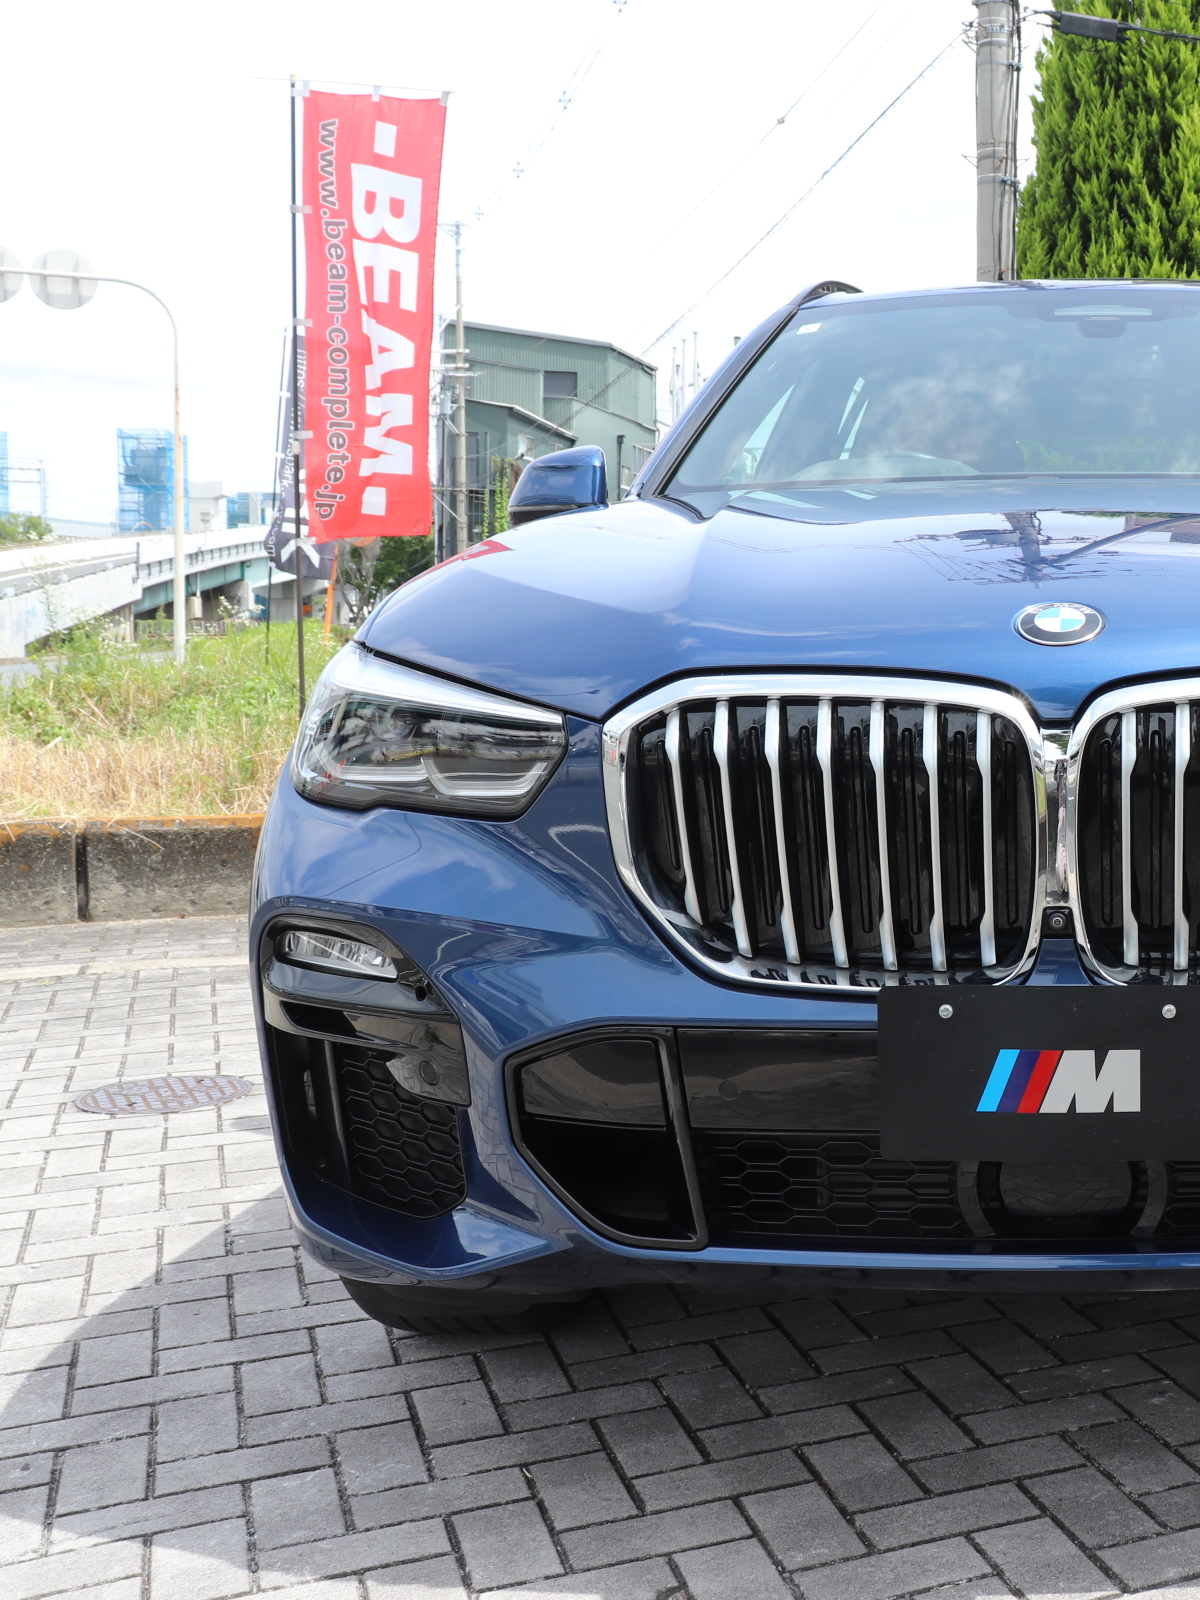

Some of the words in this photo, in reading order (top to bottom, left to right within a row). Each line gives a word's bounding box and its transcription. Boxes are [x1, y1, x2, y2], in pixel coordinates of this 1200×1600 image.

[314, 119, 354, 521] www.beam-complete.jp
[351, 163, 423, 477] BEAM
[1030, 602, 1095, 614] BMW
